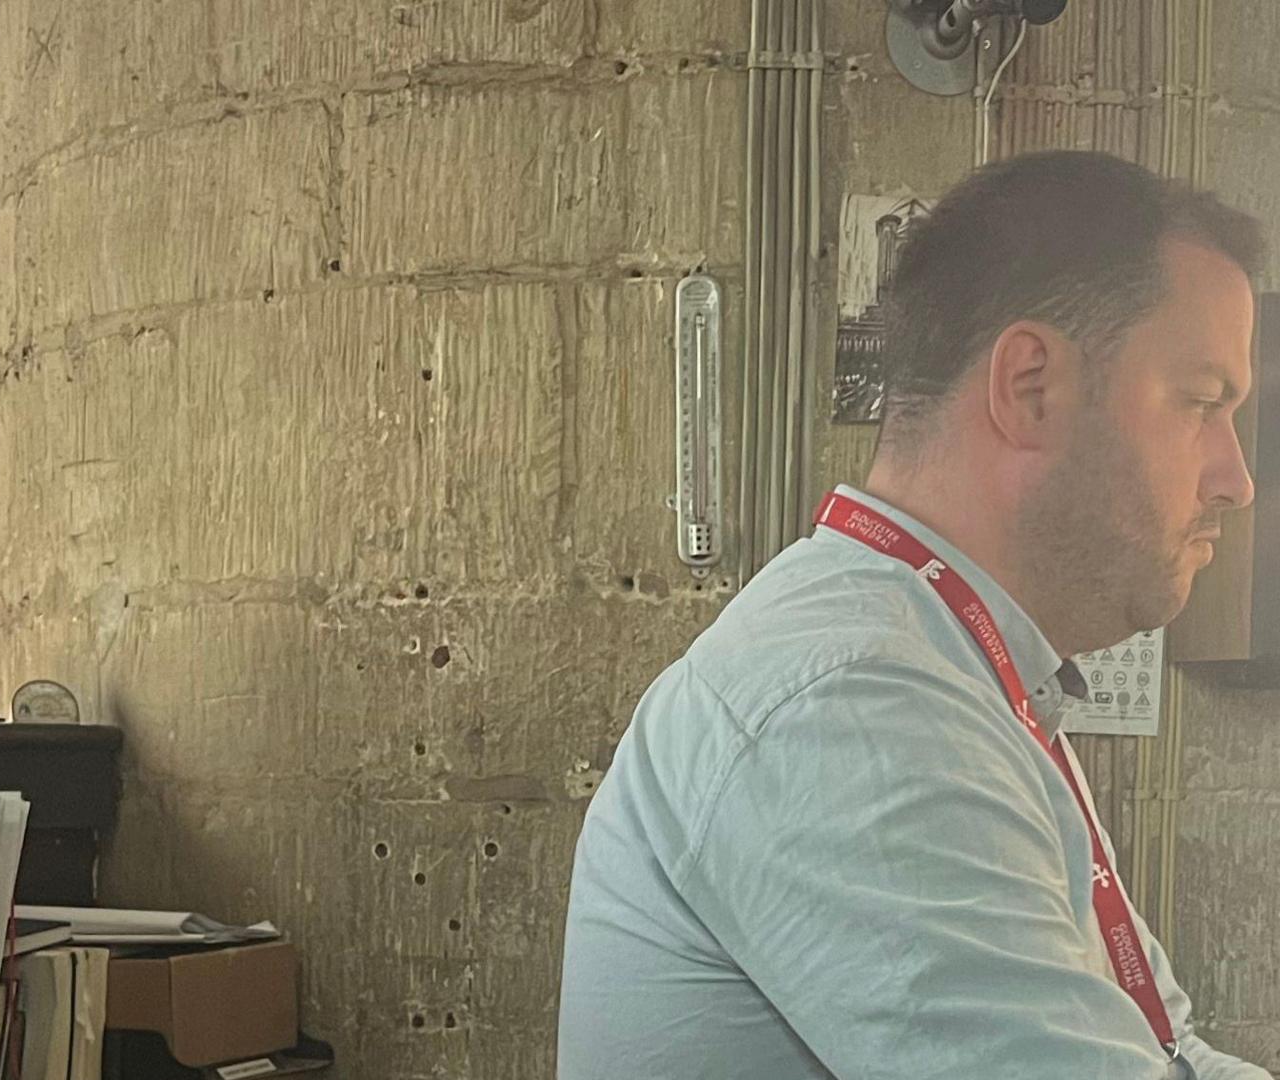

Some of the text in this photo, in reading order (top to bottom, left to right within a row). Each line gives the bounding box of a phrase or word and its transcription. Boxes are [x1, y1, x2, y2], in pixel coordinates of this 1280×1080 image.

[845, 518, 891, 549] CATHEDRAL
[850, 510, 900, 542] GLOUCESTER
[963, 606, 1003, 668] CATHEDRAL
[1110, 927, 1135, 990] CATHEDRAL
[1119, 923, 1146, 986] GLOUCESTER
